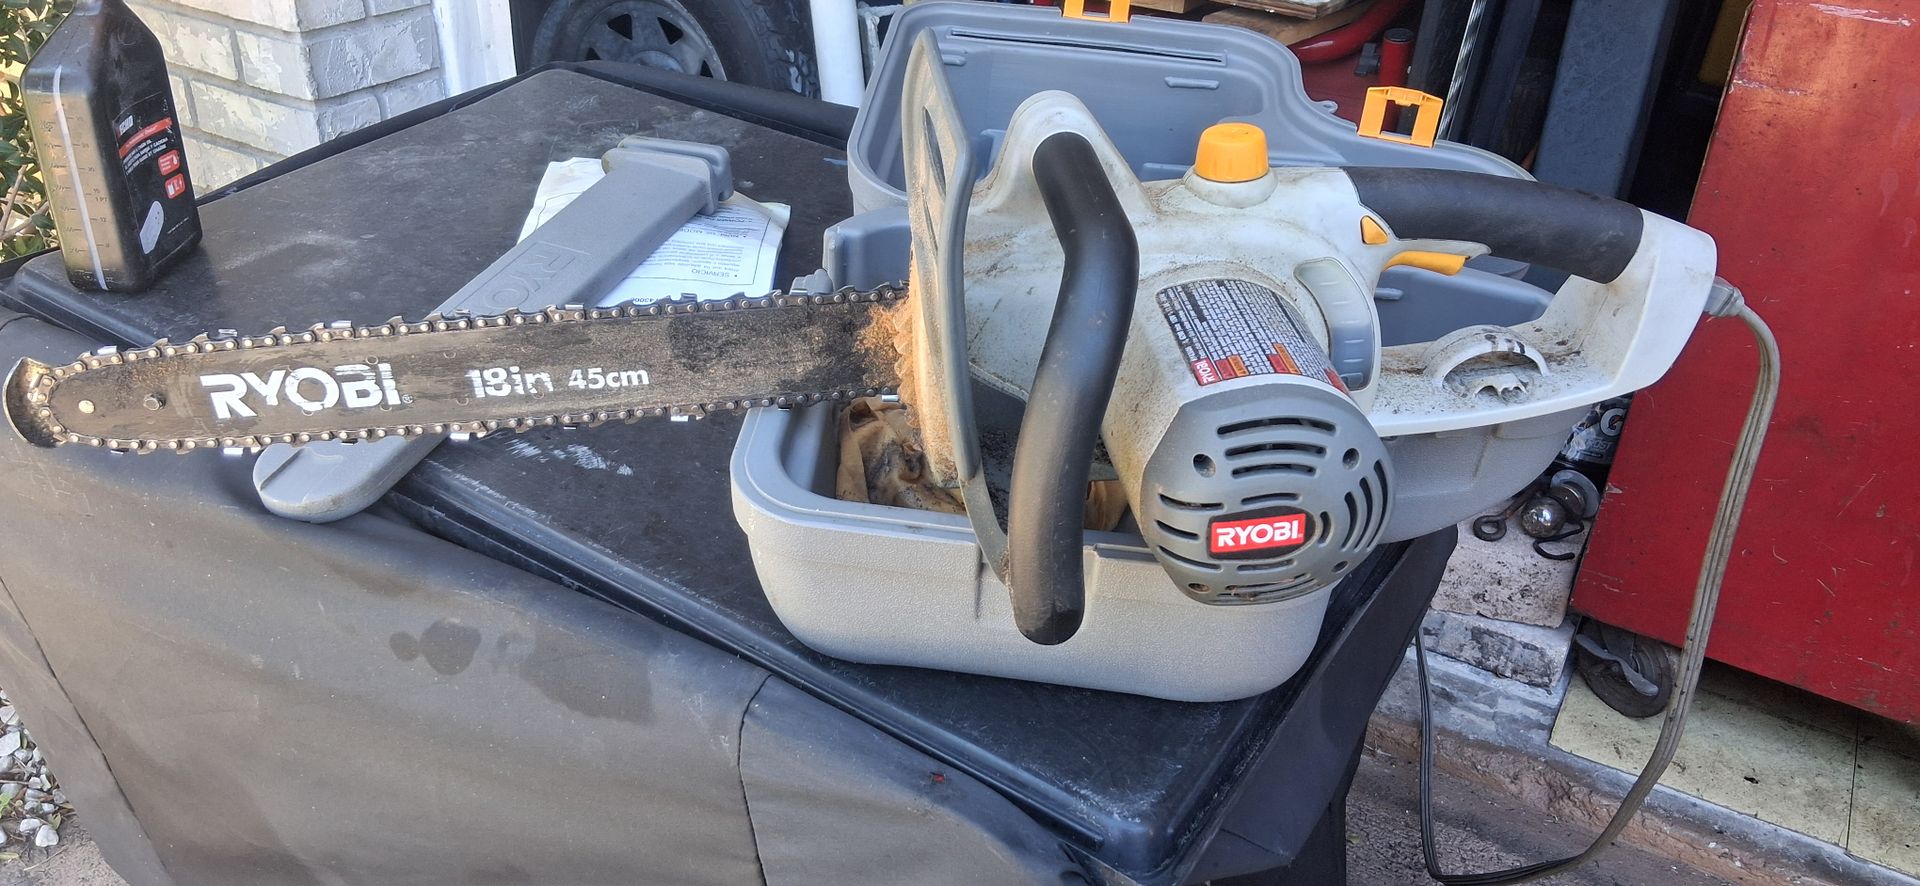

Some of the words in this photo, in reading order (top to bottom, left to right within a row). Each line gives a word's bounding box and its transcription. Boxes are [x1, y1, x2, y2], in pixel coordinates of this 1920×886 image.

[691, 268, 730, 279] SERVICIO
[1194, 360, 1216, 384] RYOBI
[200, 363, 402, 420] RYOBI
[463, 365, 555, 399] 18in
[567, 367, 650, 390] 45cm
[1216, 519, 1299, 547] RYOBI
